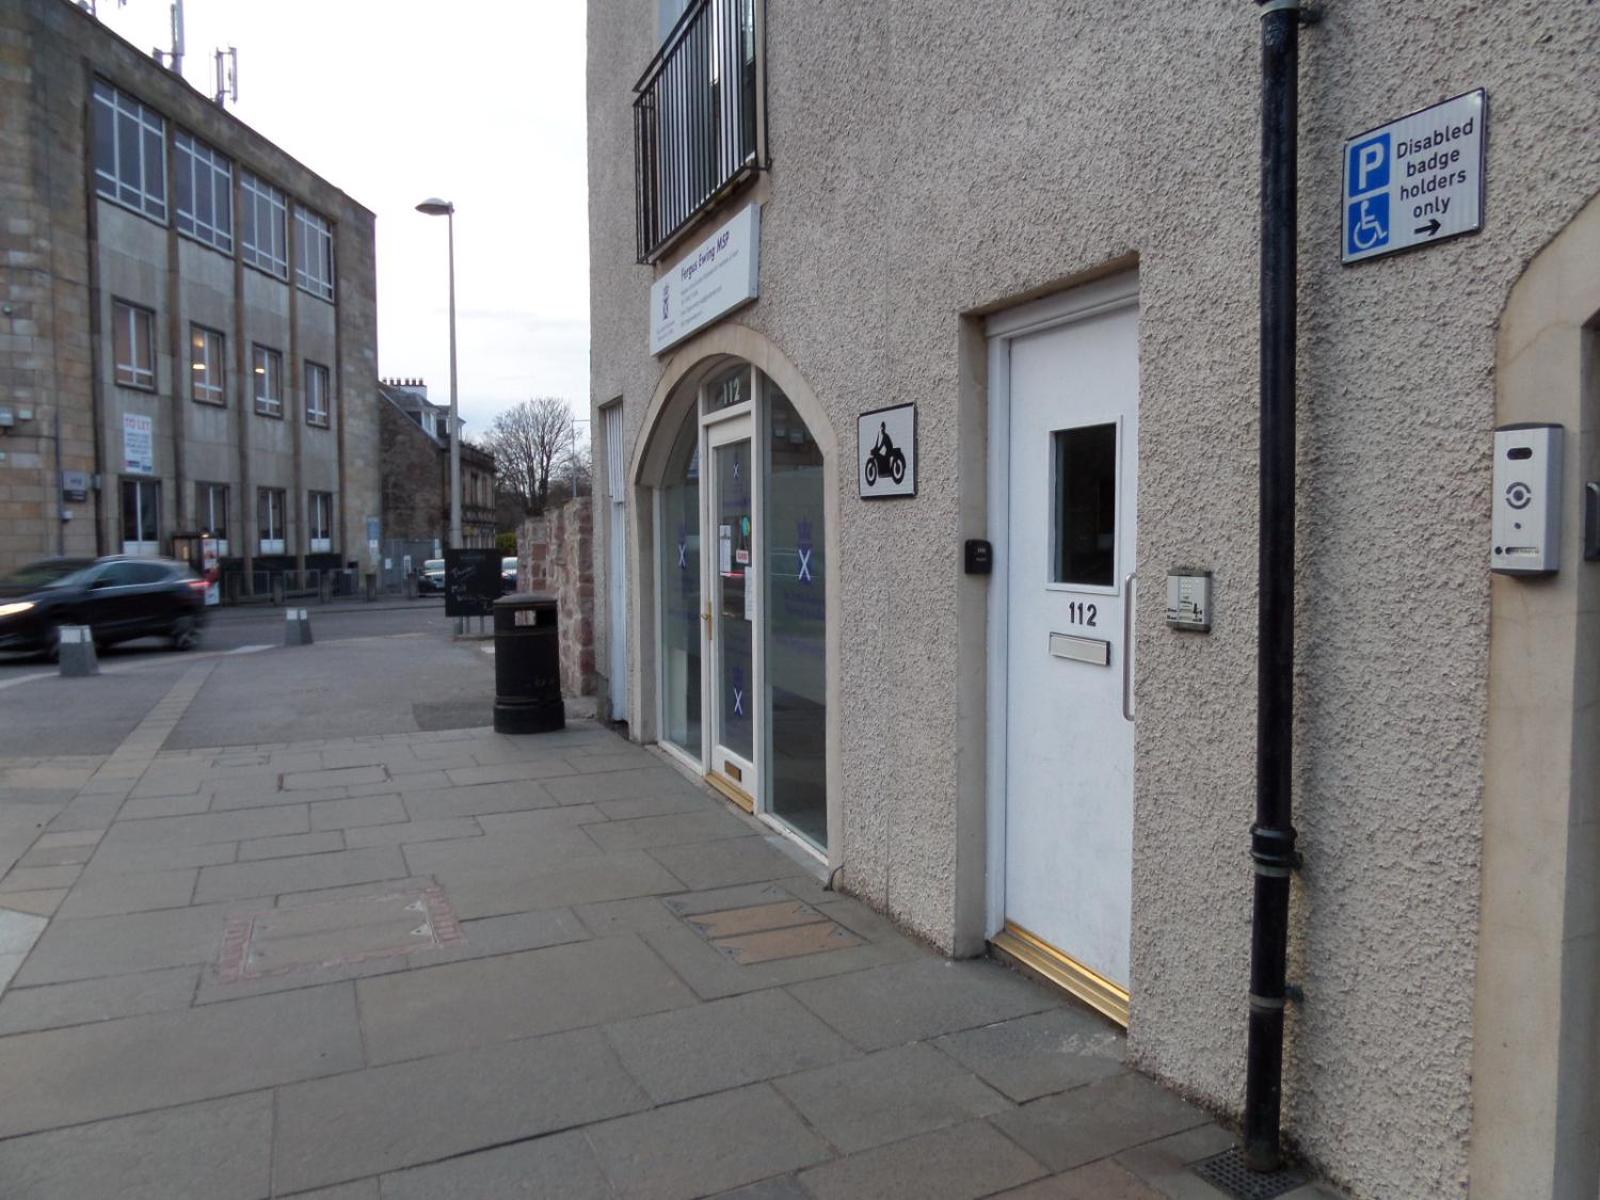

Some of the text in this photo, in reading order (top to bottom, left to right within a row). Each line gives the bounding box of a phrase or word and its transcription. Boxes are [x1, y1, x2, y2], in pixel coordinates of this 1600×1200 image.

[1397, 117, 1474, 159] Disabled
[1358, 142, 1385, 190] P
[1406, 149, 1460, 177] badge
[1400, 169, 1466, 201] holders
[1413, 197, 1451, 218] only
[681, 262, 698, 281] Fergus
[699, 246, 715, 268] Ewing
[716, 231, 730, 253] MSP
[723, 376, 740, 404] 112
[1069, 602, 1097, 626] 112
